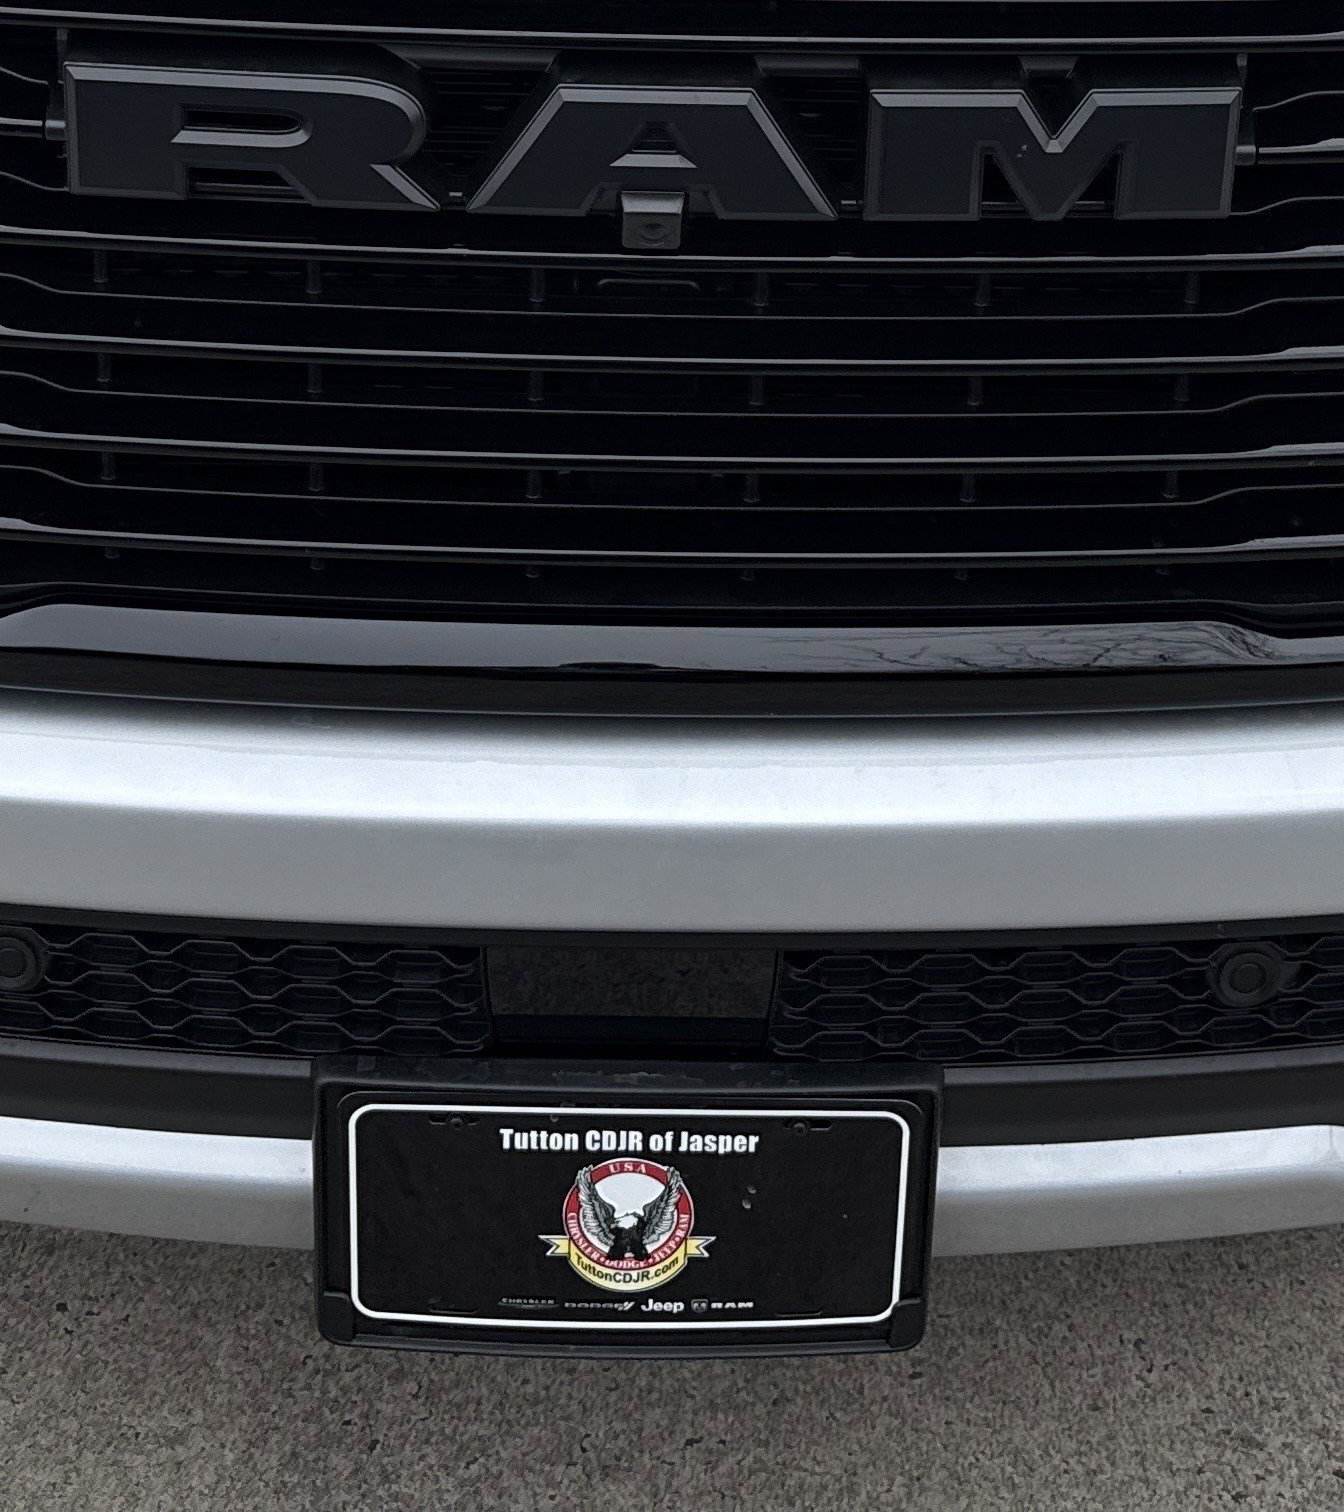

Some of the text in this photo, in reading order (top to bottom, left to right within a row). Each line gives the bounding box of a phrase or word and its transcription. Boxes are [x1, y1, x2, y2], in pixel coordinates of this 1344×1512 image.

[63, 61, 1244, 222] RAM
[499, 1128, 760, 1155] Tutton CDJR of Jasper
[608, 1162, 647, 1174] USA
[574, 1252, 680, 1284] TuttonCDJR.com
[640, 1298, 685, 1314] Jeep
[710, 1301, 755, 1309] RAM
